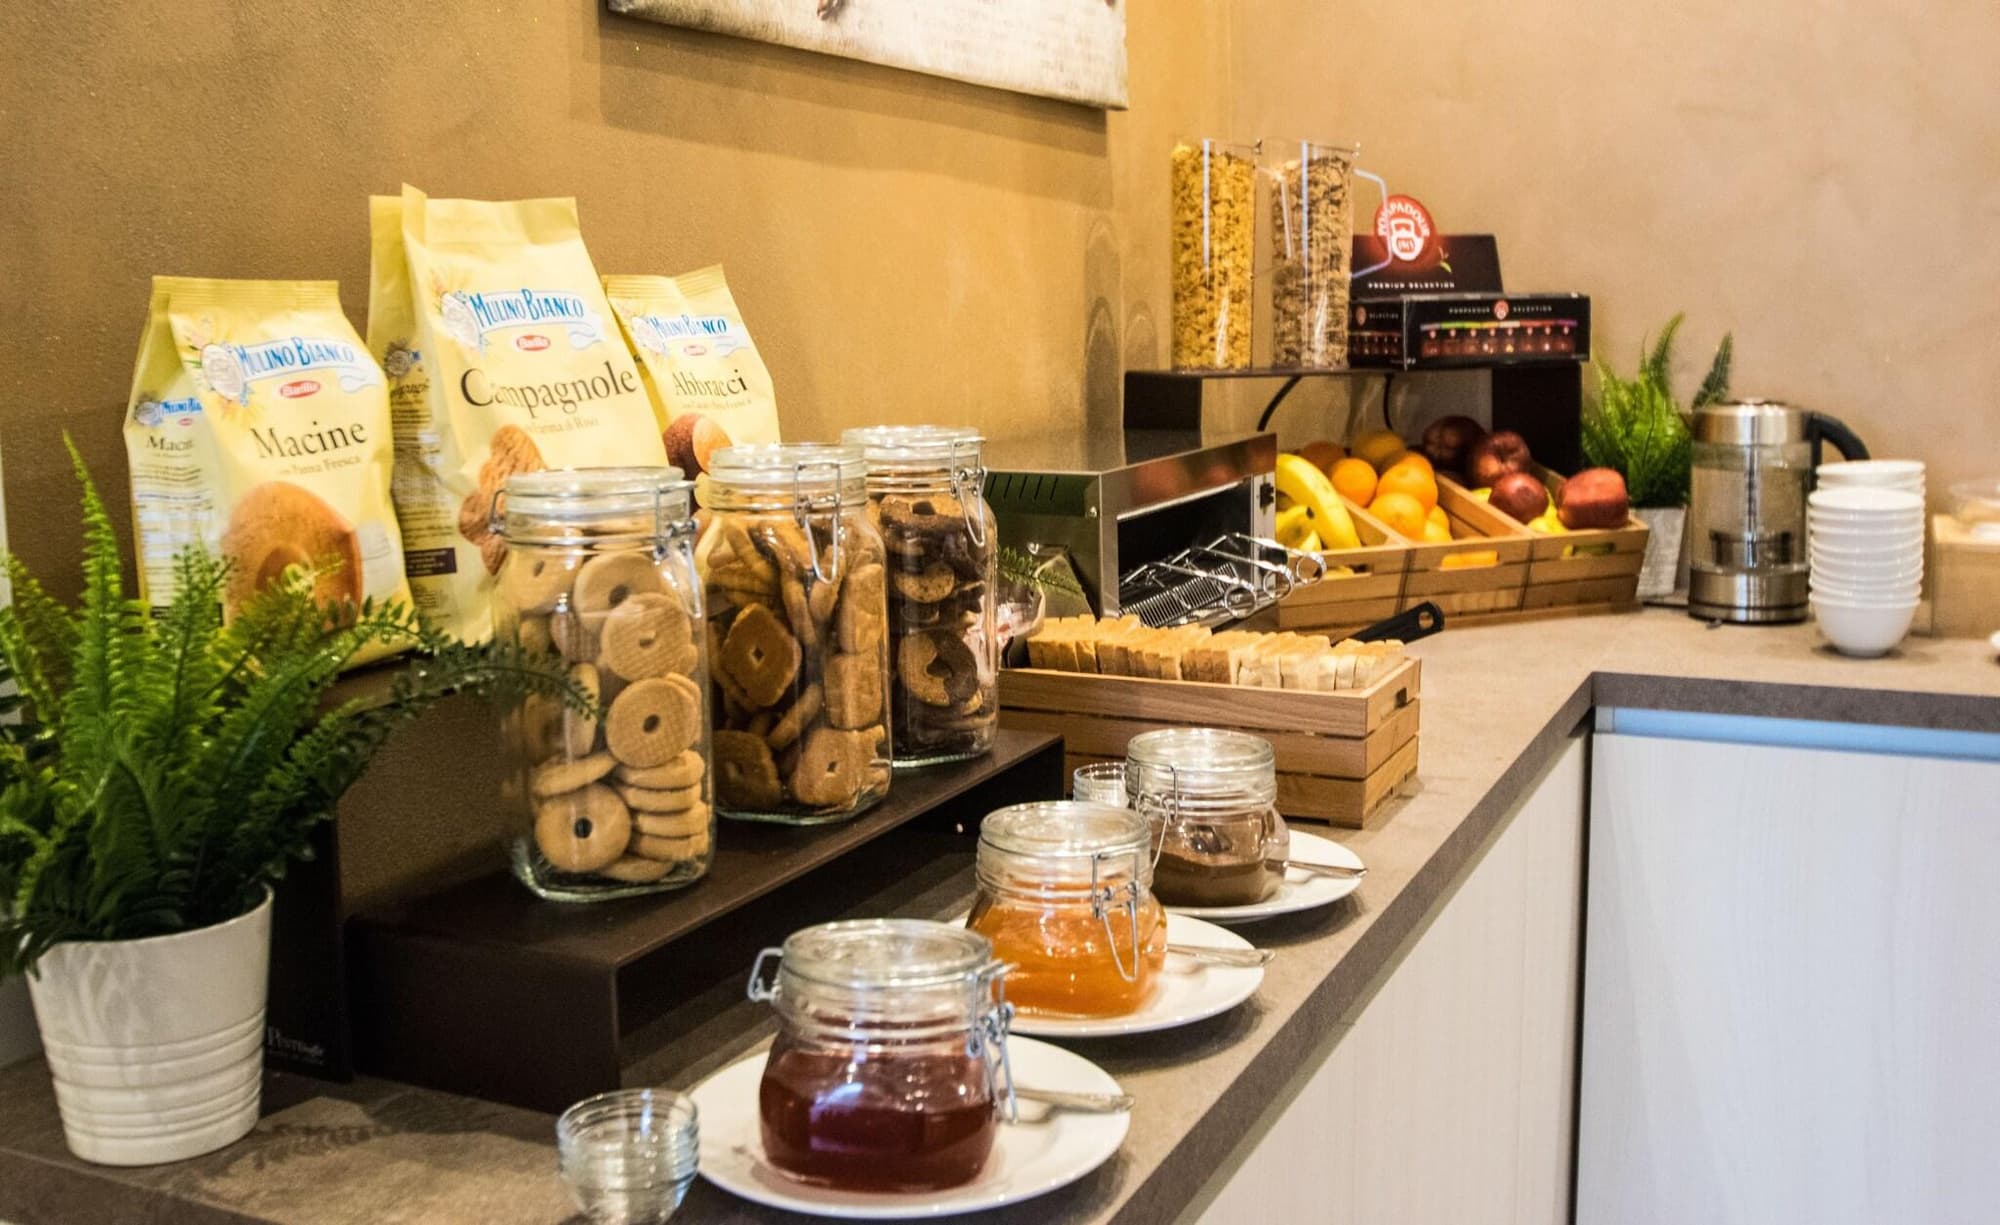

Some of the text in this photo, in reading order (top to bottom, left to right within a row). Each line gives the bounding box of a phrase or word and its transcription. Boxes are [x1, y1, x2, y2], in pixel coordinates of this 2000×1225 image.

[460, 360, 637, 419] Campagnole
[671, 368, 748, 398] Abbracci
[249, 420, 367, 458] Macine
